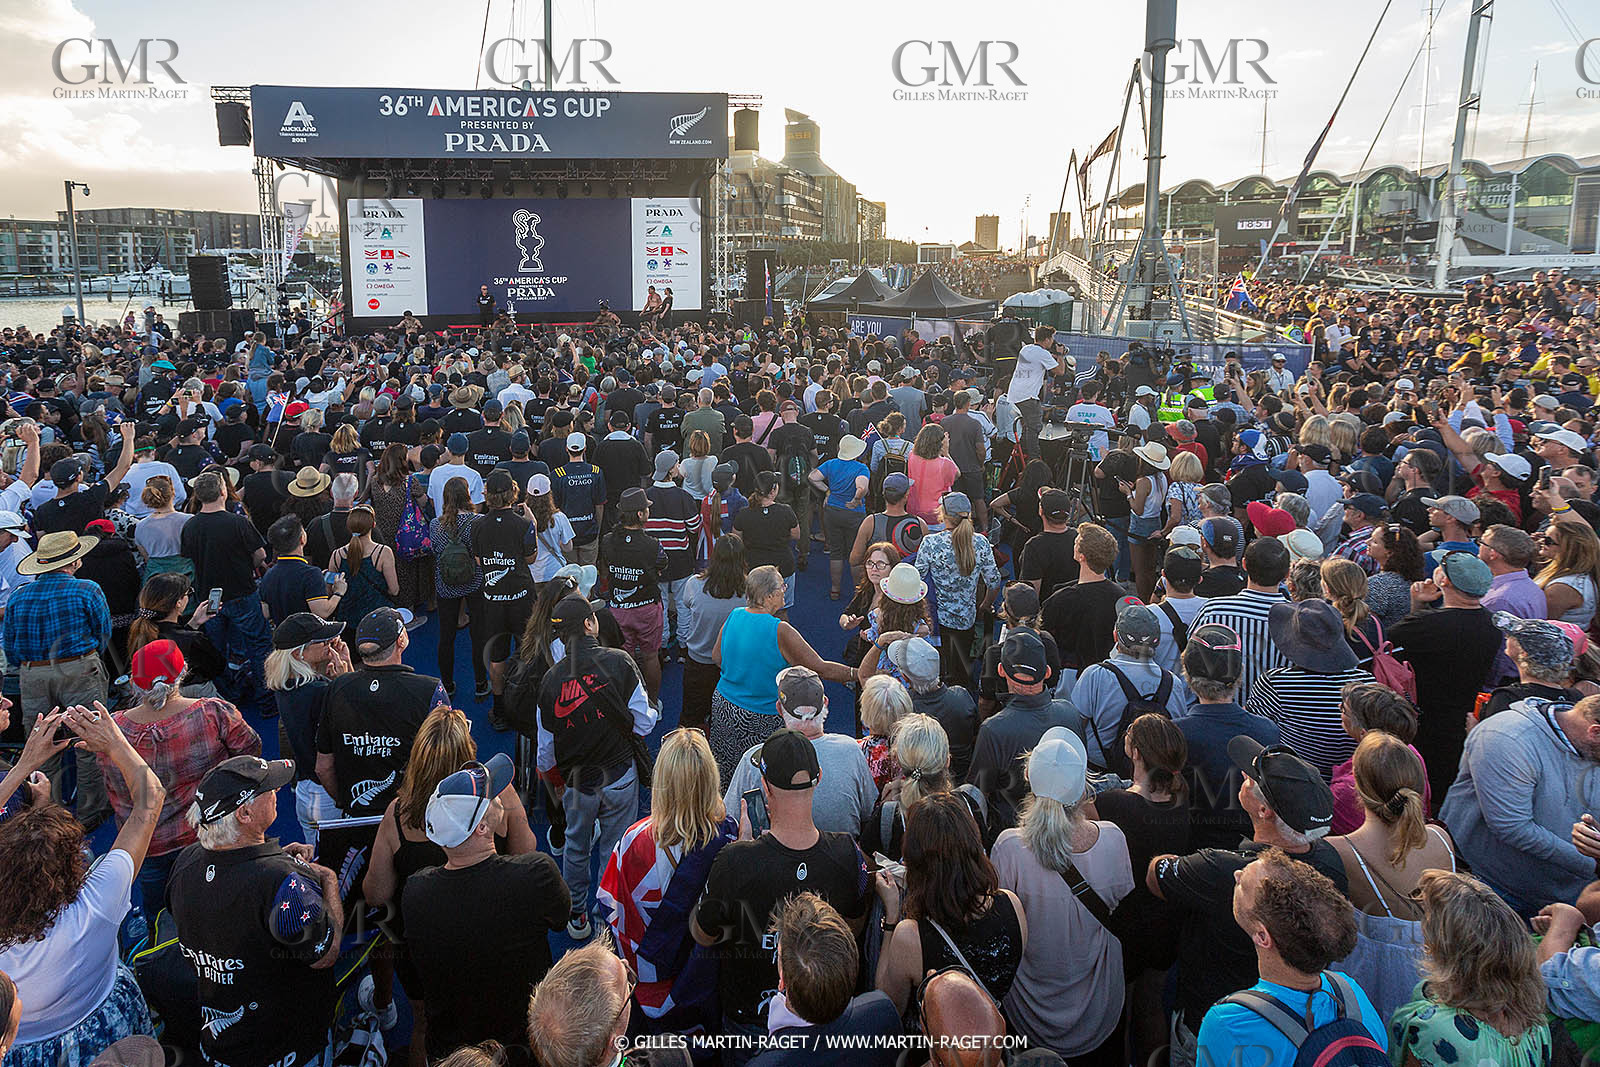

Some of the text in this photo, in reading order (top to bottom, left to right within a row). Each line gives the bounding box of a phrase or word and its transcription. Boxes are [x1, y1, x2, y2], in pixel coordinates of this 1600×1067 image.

[379, 95, 611, 118] 36TH AMERICA'S CUP
[461, 121, 534, 130] PRESENTED BY
[444, 133, 551, 153] PRADA
[362, 210, 404, 218] PRADA
[645, 208, 684, 217] PRADA
[508, 277, 551, 285] AMERICA'S
[551, 276, 568, 284] CUP
[507, 287, 556, 298] PRADA
[851, 320, 882, 336] ARE YOU
[1077, 411, 1096, 419] STAFF
[474, 453, 500, 461] Emirates
[568, 478, 593, 486] OTAGO
[483, 556, 516, 566] Emirates
[608, 564, 645, 576] Emirates
[493, 589, 528, 601] ZEALAND
[342, 732, 401, 747] Emirates
[203, 966, 234, 985] BETTER
